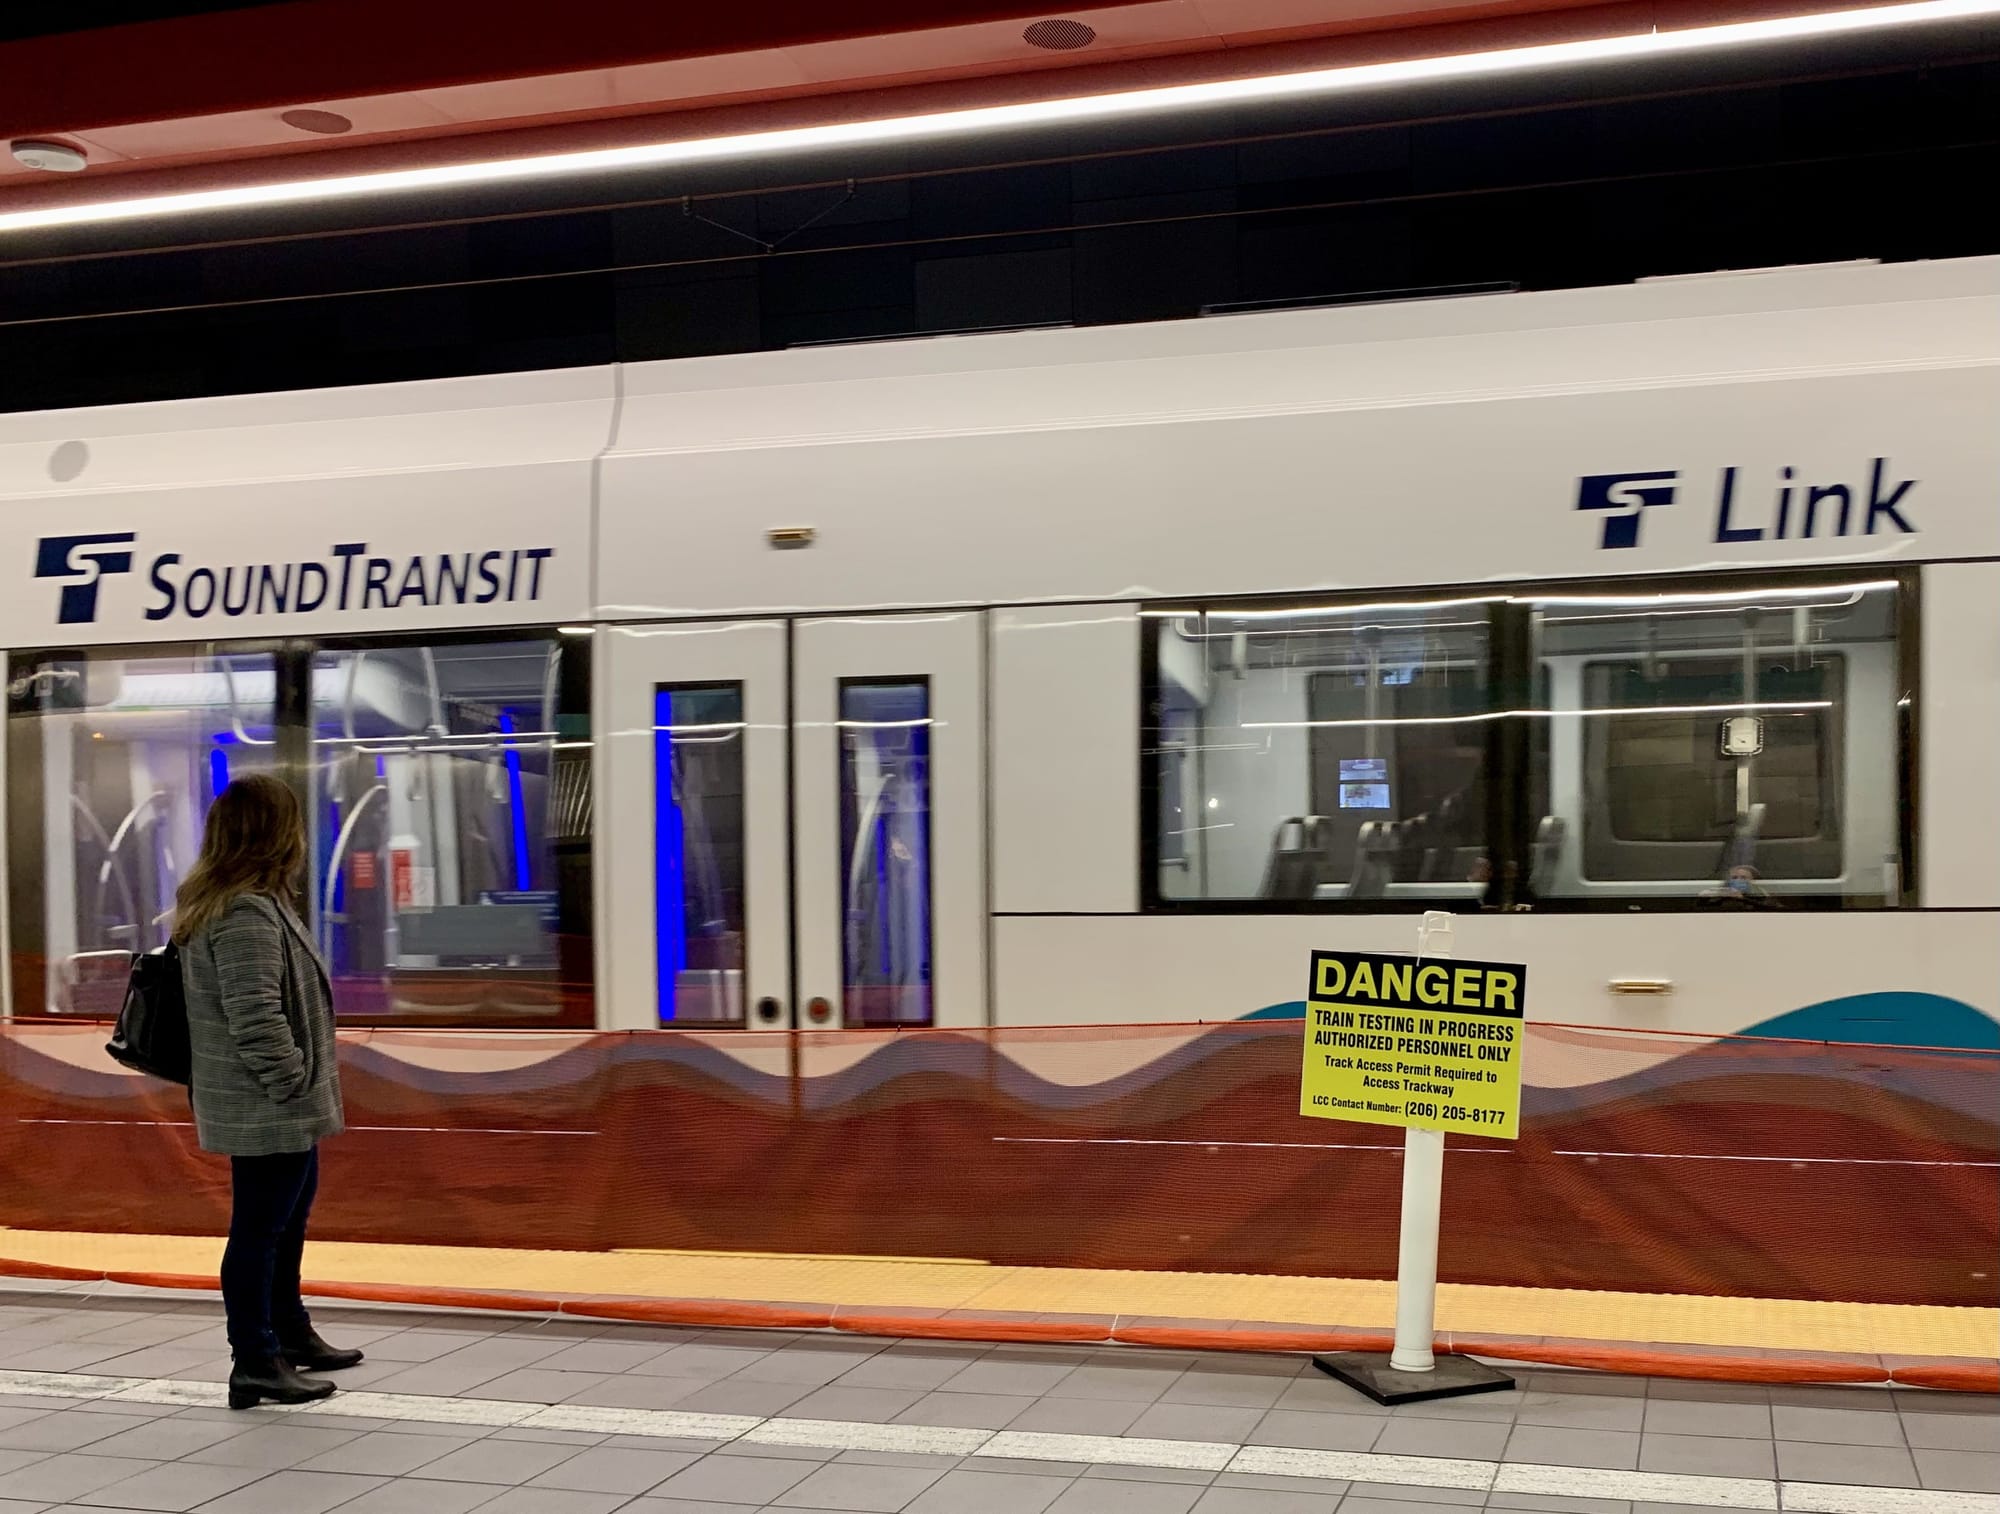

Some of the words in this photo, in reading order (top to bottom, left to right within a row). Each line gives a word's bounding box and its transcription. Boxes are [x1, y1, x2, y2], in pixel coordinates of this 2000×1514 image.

[1715, 457, 1917, 543] Link
[1316, 959, 1517, 1010] DANGER
[1315, 1009, 1354, 1028] TRAIN
[1359, 1013, 1414, 1033] TESTING
[1420, 1019, 1433, 1034] IN
[1438, 1021, 1514, 1042] PROGRESS
[1315, 1030, 1393, 1051] AUTHORIZED
[1398, 1038, 1473, 1059] PERSONNEL
[1478, 1045, 1511, 1062] ONLY
[1324, 1055, 1353, 1069] Track
[1356, 1059, 1393, 1073] Access
[1396, 1062, 1431, 1076] Permit
[1434, 1066, 1483, 1083] Required
[1486, 1071, 1497, 1083] to
[1363, 1075, 1400, 1090] Access
[1403, 1079, 1454, 1098] Trackway
[1313, 1095, 1329, 1106] LCC
[1331, 1097, 1364, 1110] Contact
[1366, 1101, 1402, 1114] Number:
[1404, 1102, 1438, 1120] (206)
[1442, 1105, 1505, 1125] 205-8177
